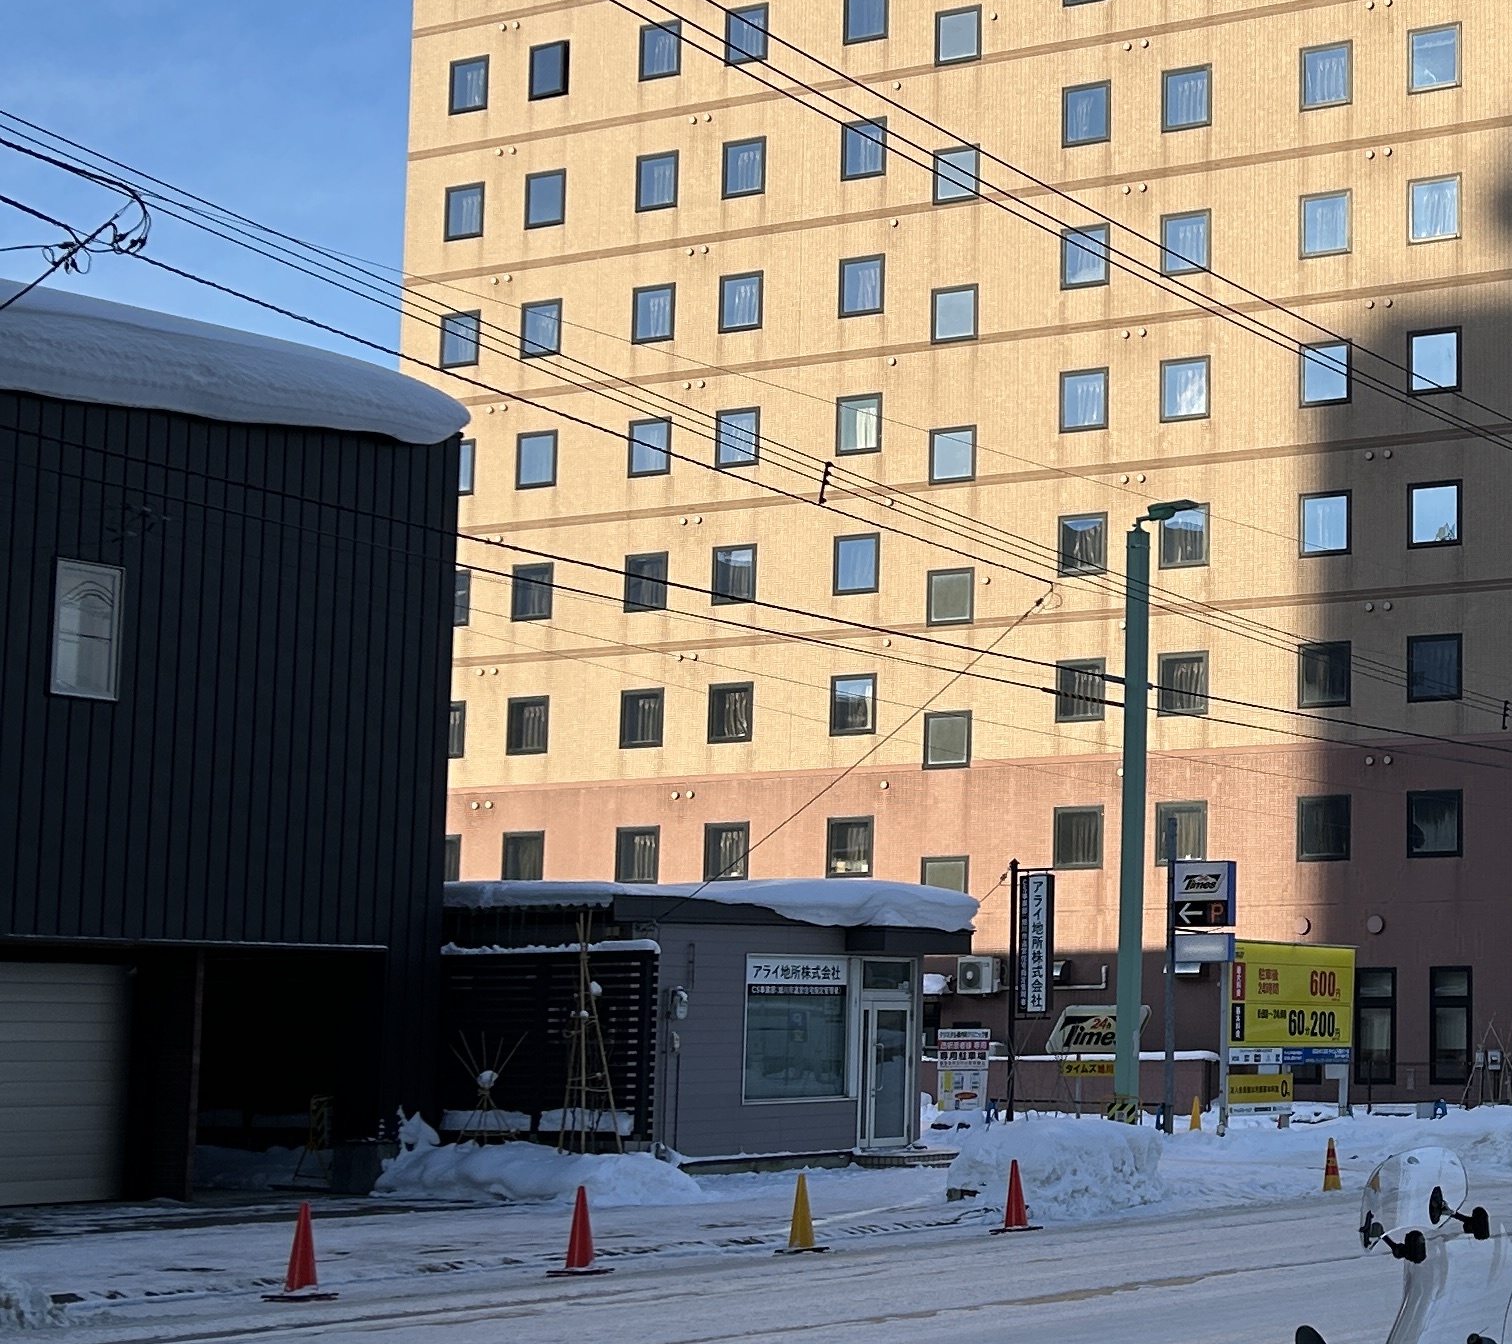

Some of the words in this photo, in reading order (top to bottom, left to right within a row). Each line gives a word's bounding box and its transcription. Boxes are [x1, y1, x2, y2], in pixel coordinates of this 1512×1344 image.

[1183, 873, 1222, 891] Times
[1210, 903, 1225, 924] P
[1030, 880, 1044, 1009] アライ地所株式会社
[752, 964, 841, 980] アライ地所株式会社
[1310, 970, 1341, 998] 600円
[1059, 1015, 1117, 1047] Time
